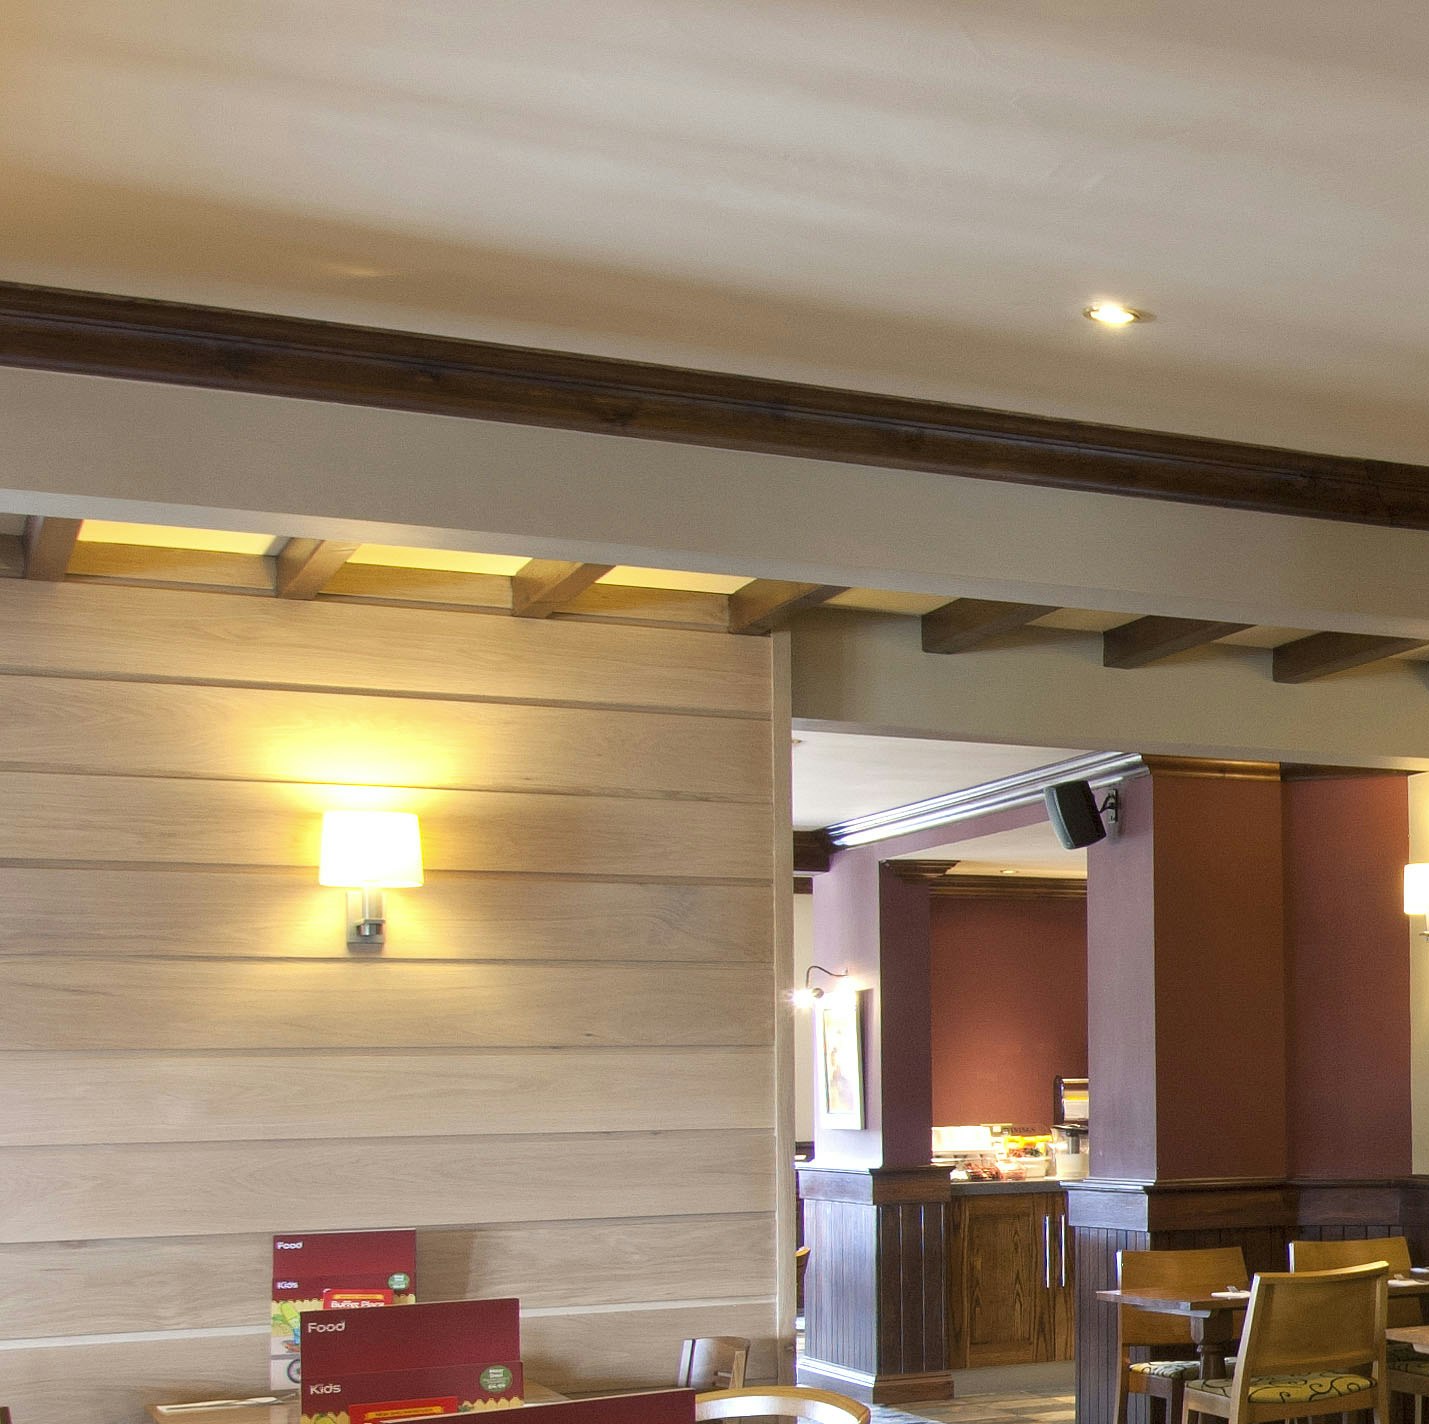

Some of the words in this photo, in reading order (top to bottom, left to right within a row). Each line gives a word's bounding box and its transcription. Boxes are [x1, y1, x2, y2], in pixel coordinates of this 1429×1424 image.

[277, 1241, 303, 1250] Food
[307, 1320, 346, 1333] Food
[309, 1383, 341, 1394] Kids
